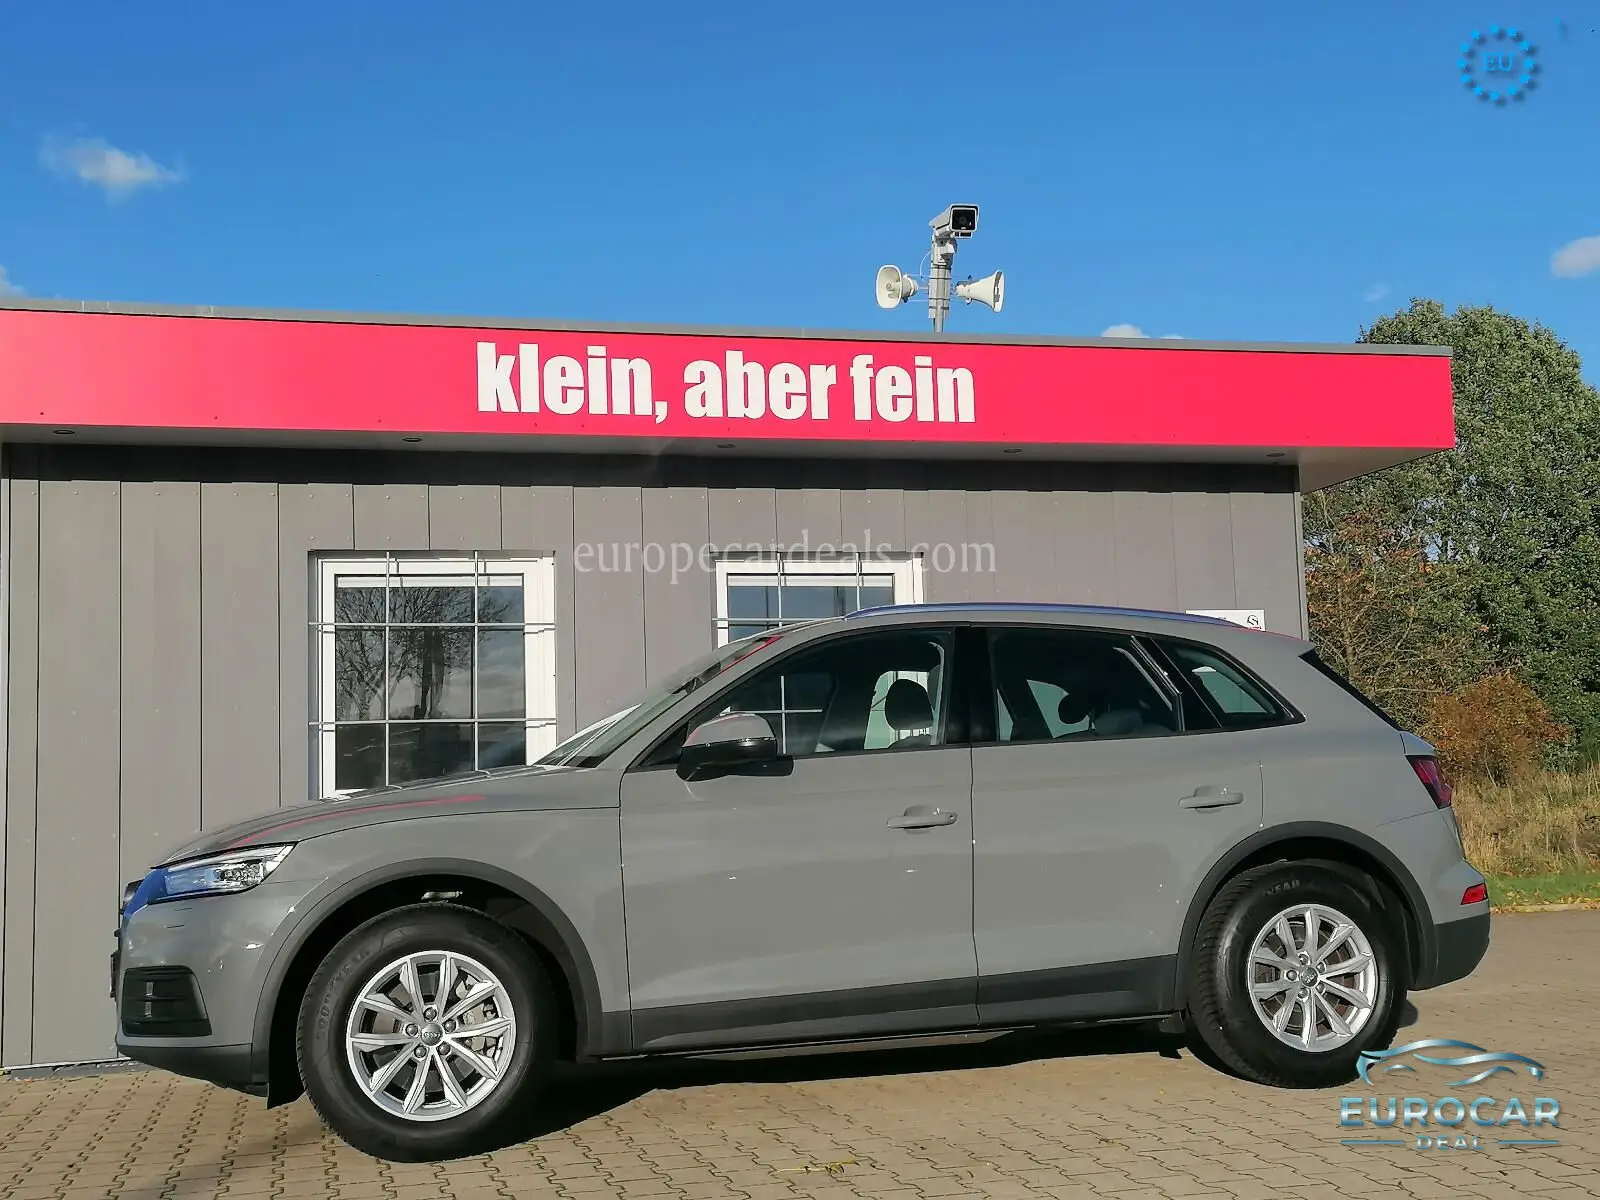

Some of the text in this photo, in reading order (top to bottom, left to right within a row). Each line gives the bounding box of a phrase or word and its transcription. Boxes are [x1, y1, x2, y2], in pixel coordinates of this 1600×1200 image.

[476, 341, 977, 424] klein, aber fein
